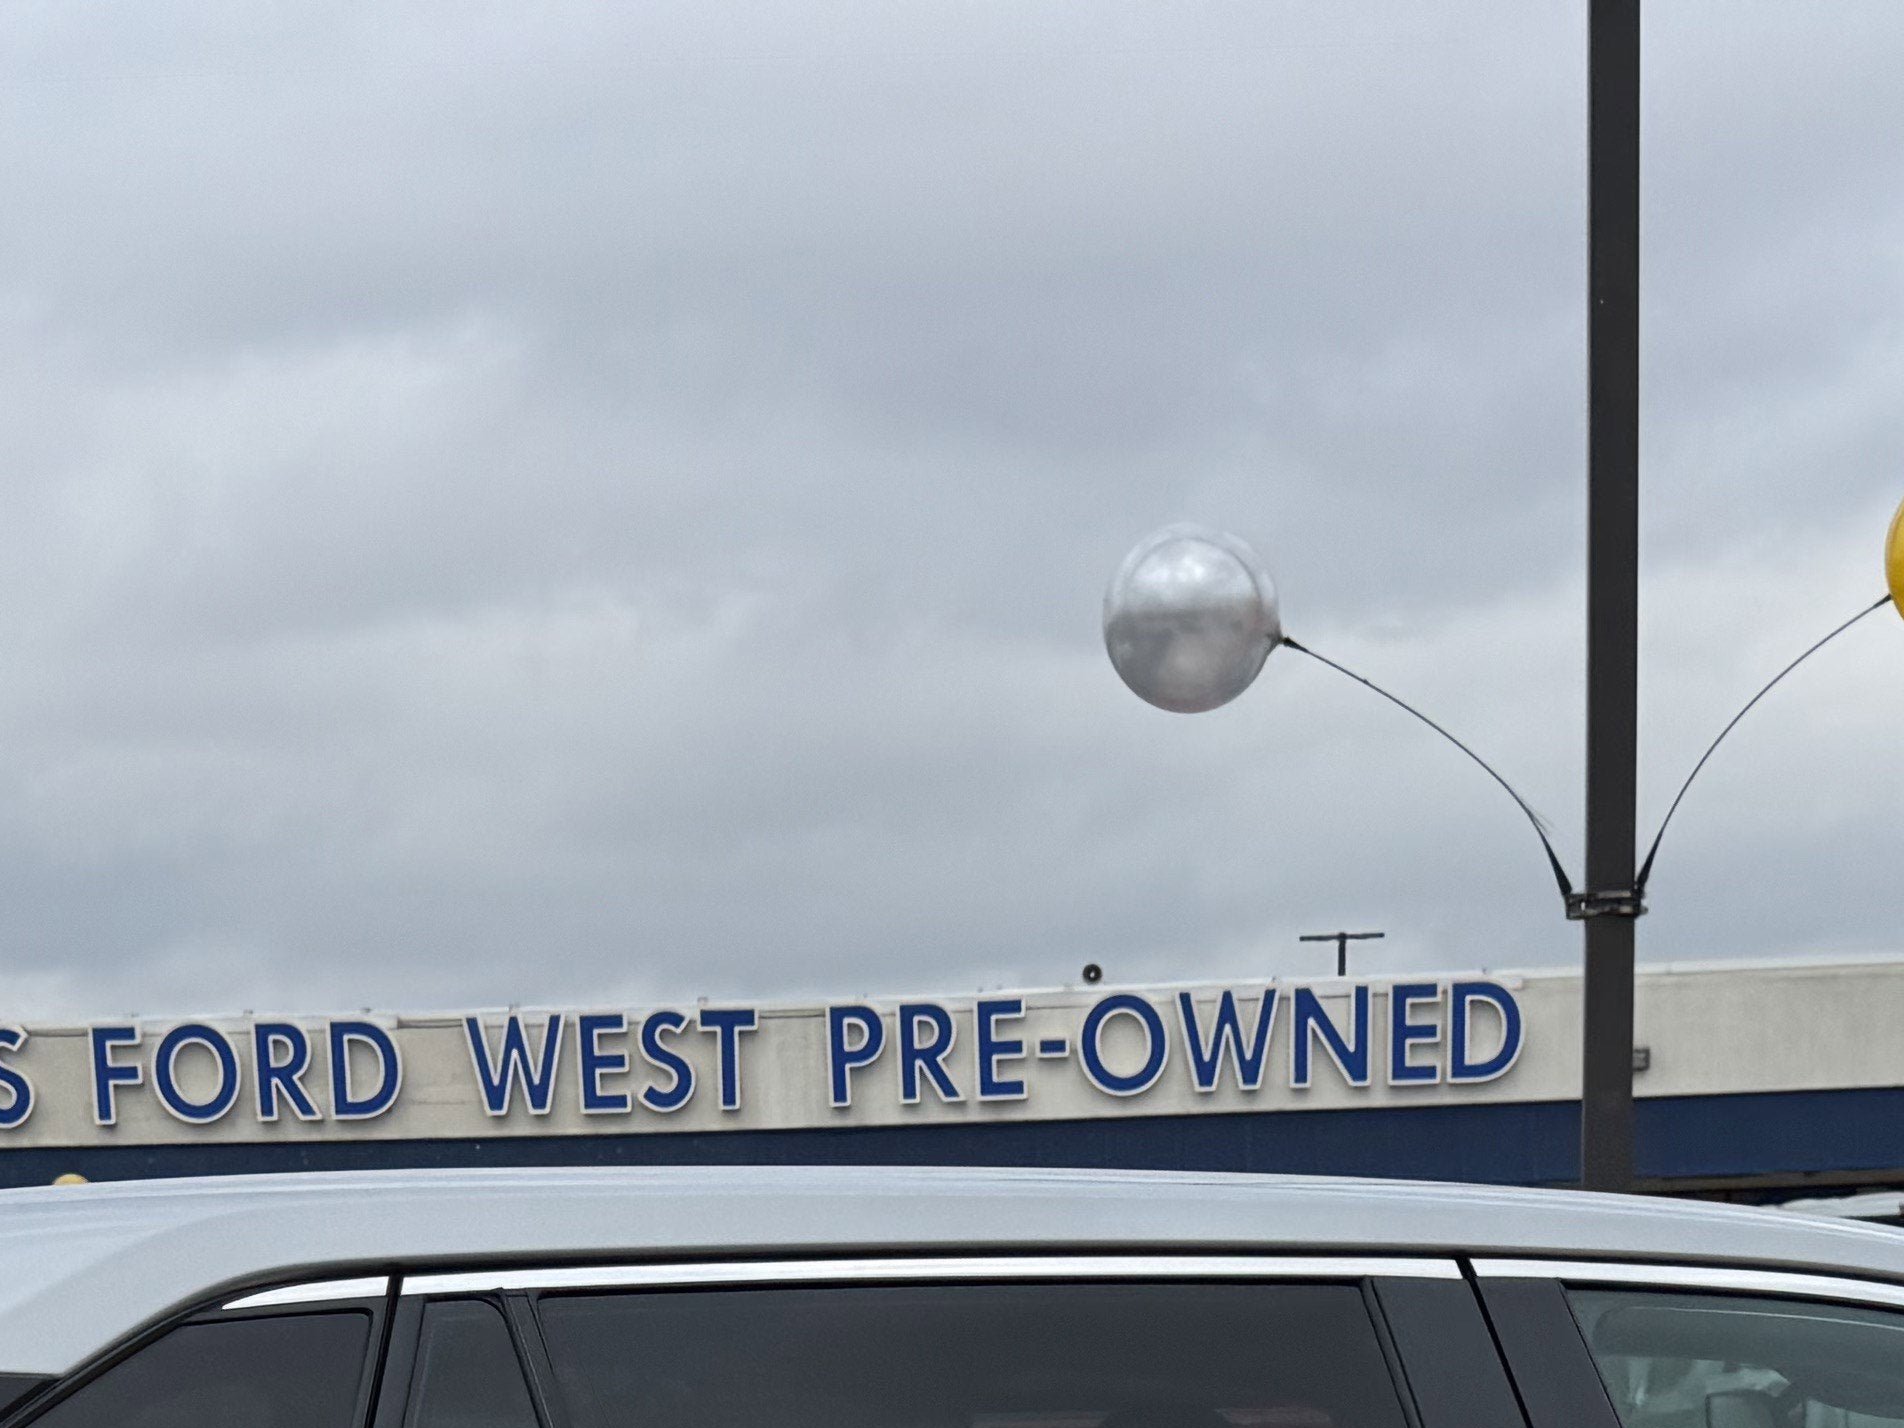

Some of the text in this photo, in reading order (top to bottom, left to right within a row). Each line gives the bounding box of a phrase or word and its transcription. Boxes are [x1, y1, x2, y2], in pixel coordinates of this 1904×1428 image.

[92, 1021, 400, 1123] FORD
[467, 1009, 756, 1113] WEST
[829, 981, 1522, 1104] PRE-OWNED
